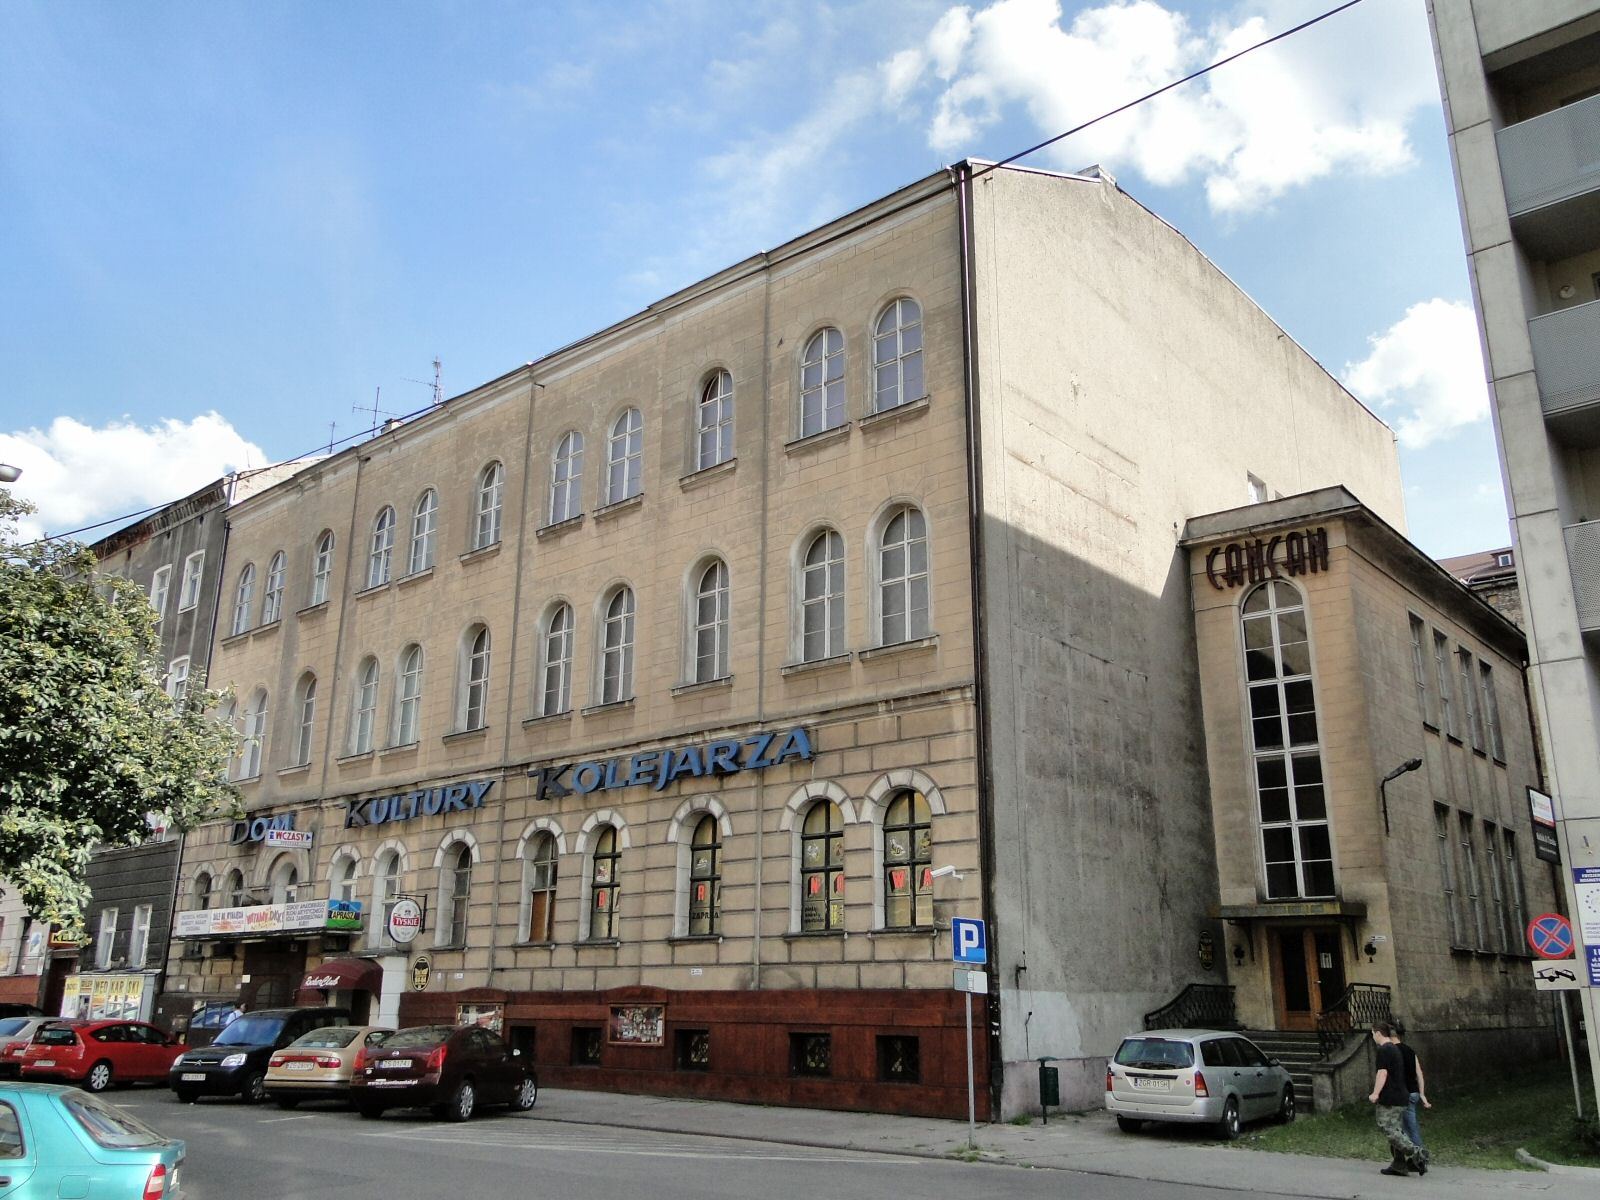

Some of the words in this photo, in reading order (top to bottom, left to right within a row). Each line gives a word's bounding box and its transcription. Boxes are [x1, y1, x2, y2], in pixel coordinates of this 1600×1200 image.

[1206, 526, 1329, 590] CANCAN
[230, 812, 296, 846] DOM
[341, 780, 496, 829] KULTURY
[529, 727, 814, 801] KOLEJARZA
[276, 831, 305, 841] WCZASY
[396, 917, 418, 926] TYSKIE
[960, 923, 979, 957] P
